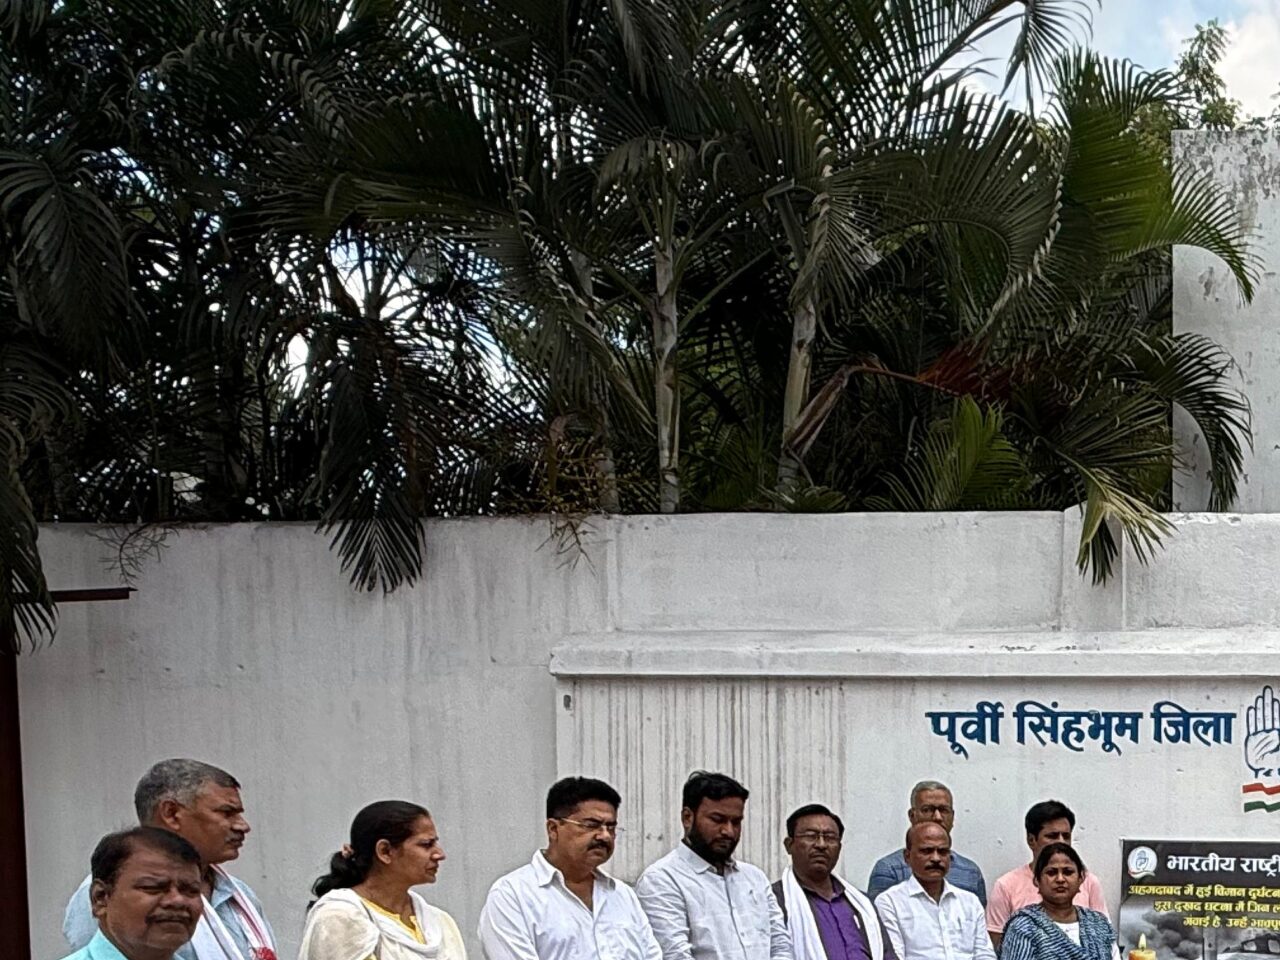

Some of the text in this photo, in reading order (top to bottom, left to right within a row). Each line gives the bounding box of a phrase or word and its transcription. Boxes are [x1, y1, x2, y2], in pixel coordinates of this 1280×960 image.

[925, 701, 1005, 760] पूर्वी
[1013, 700, 1144, 756] सिंहभूम
[1150, 701, 1237, 747] जिला
[1167, 853, 1237, 872] भारतीय
[1184, 884, 1194, 897] में
[1196, 885, 1211, 898] हुई
[1214, 884, 1246, 897] विमान
[1154, 900, 1172, 912] इस
[1204, 902, 1233, 912] घटना
[1247, 901, 1270, 913] जिन
